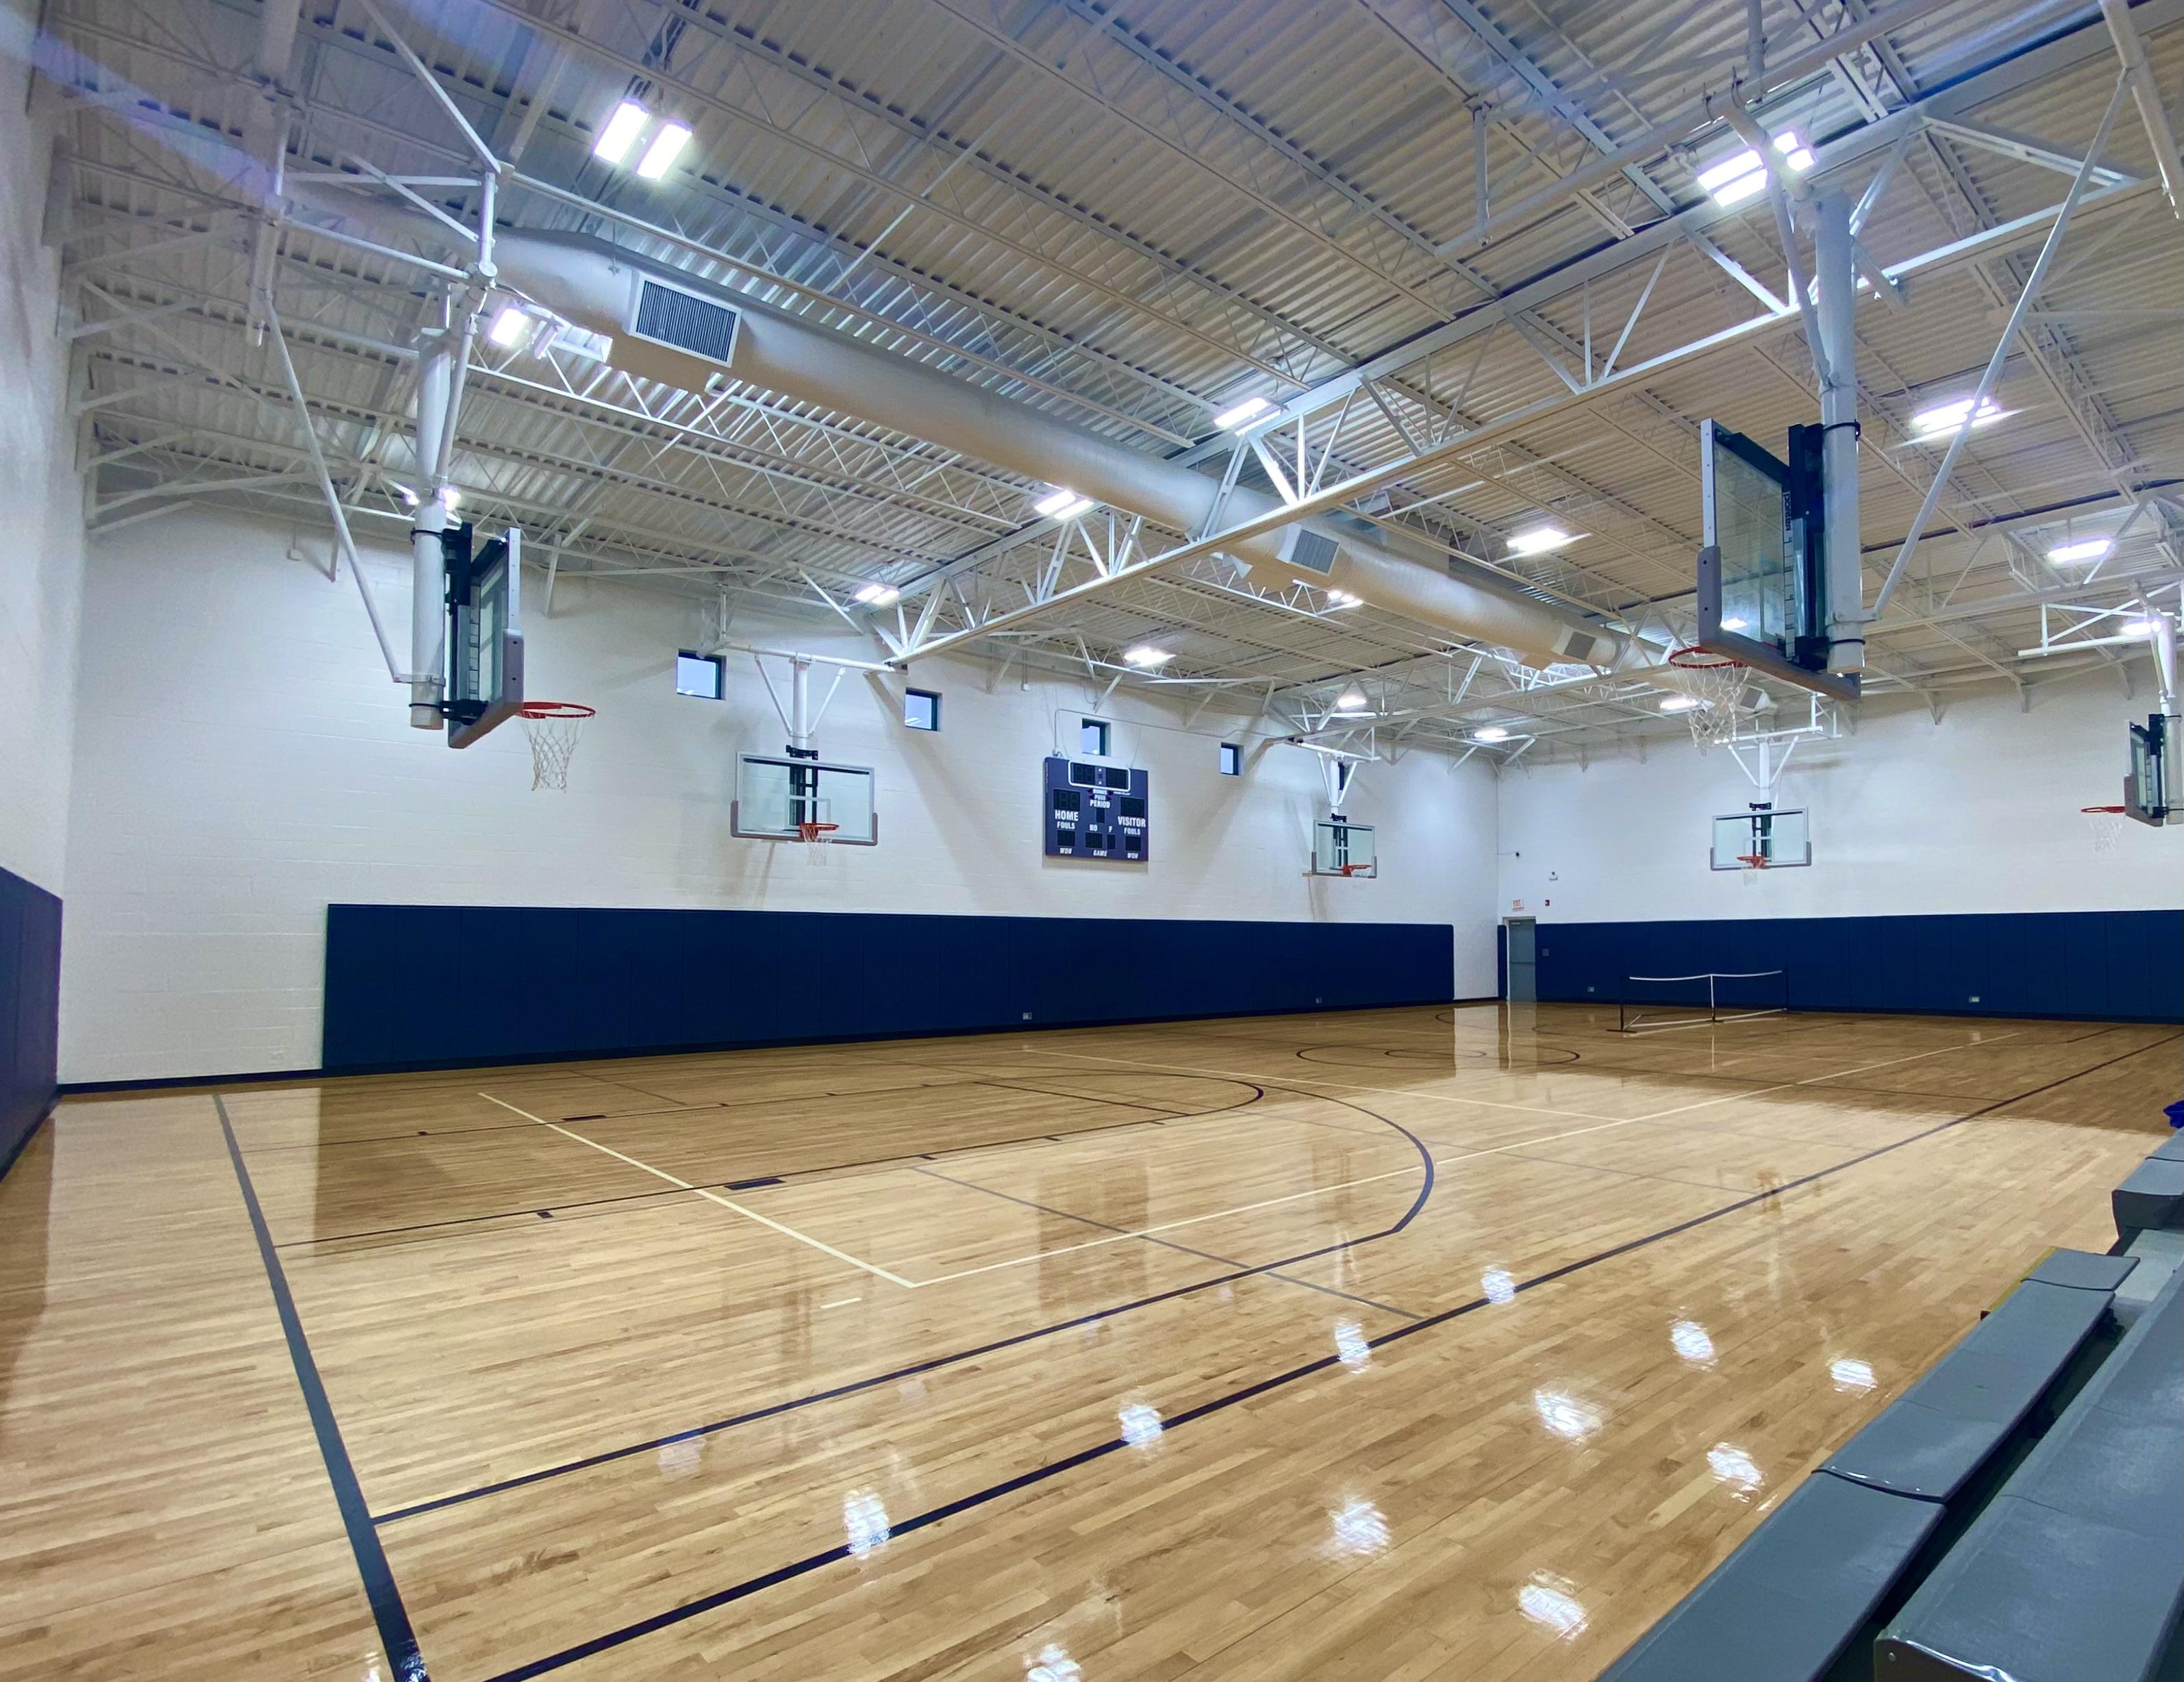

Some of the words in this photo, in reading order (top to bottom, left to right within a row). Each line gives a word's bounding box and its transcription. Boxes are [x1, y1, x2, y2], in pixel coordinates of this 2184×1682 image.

[1090, 799, 1110, 808] PERIOD
[1055, 809, 1079, 821] HOME
[1057, 821, 1075, 829] FOULS
[1117, 816, 1146, 827] VISITOR
[1124, 827, 1140, 836] FOULS
